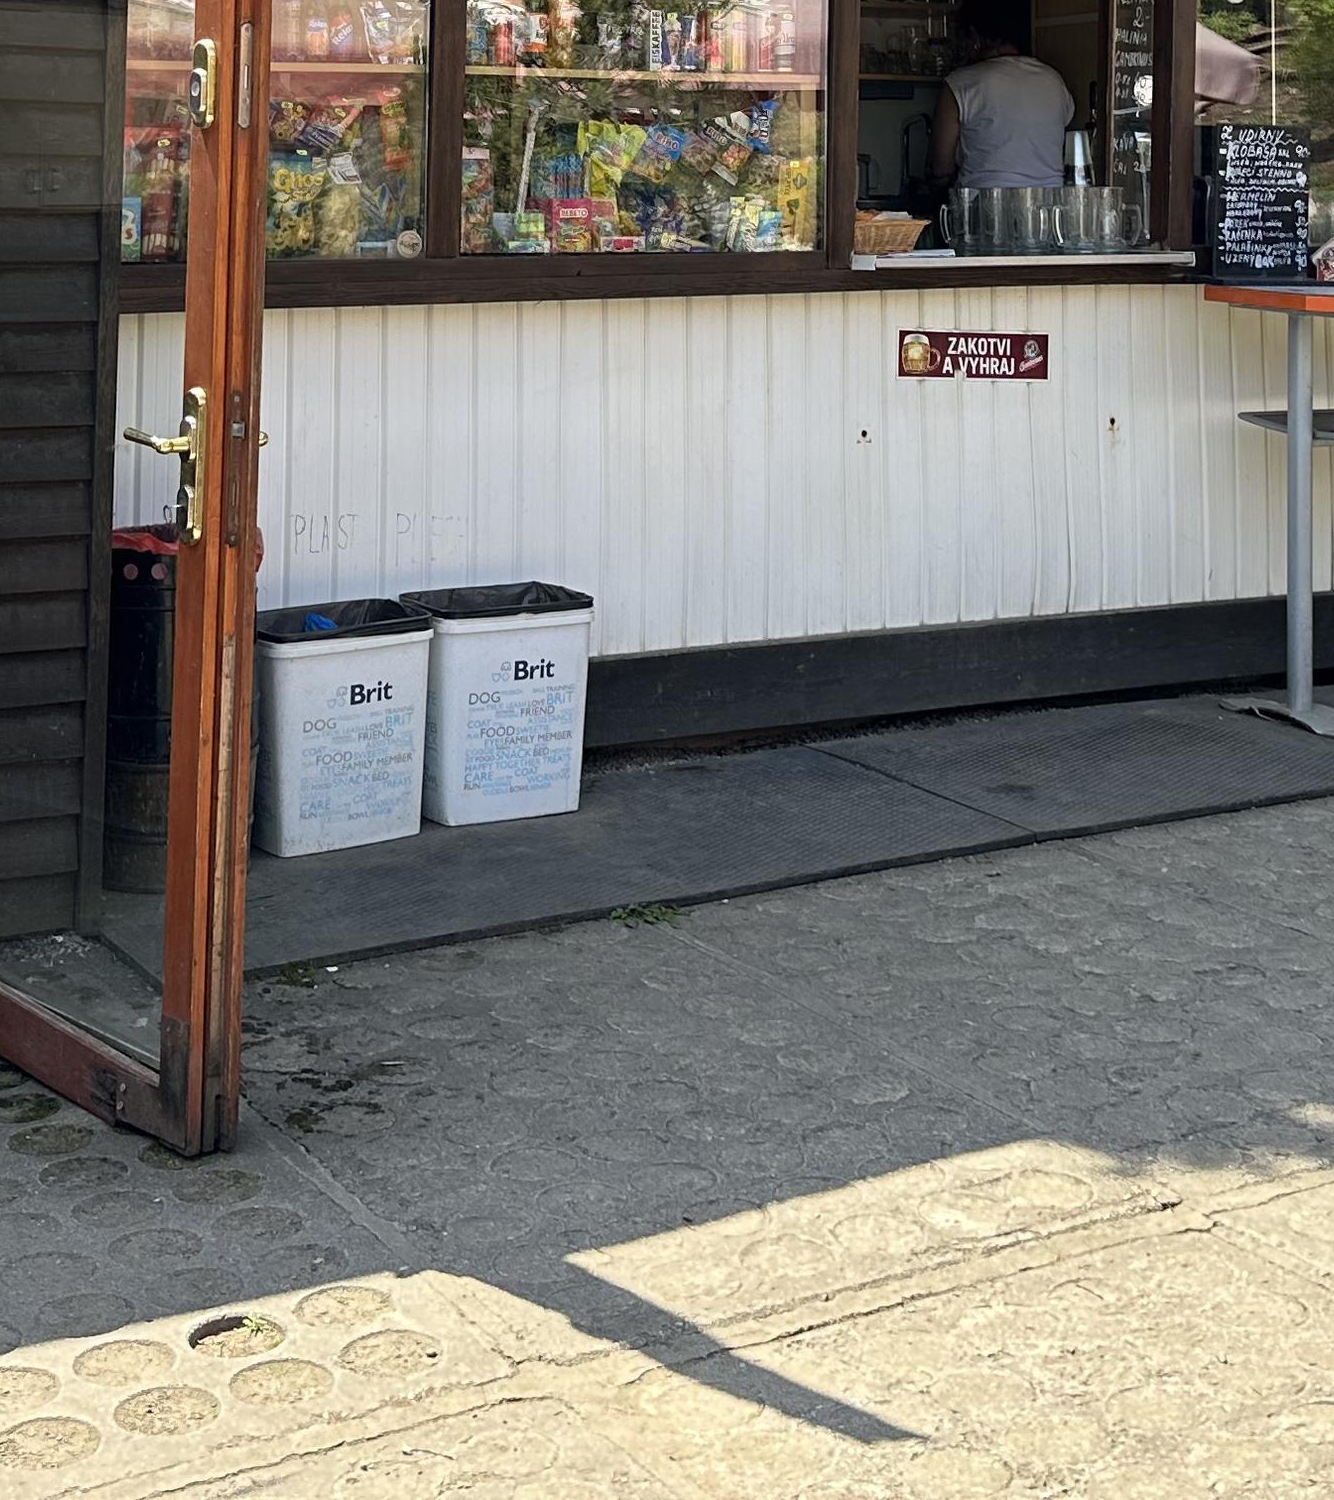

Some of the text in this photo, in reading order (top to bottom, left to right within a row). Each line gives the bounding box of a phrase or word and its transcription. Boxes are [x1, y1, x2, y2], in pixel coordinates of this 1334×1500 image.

[948, 337, 1011, 356] ZAKOTVI
[942, 357, 953, 374] A
[959, 357, 1015, 376] VYHRAJ
[514, 658, 555, 681] Brit
[350, 681, 393, 706] Brit
[468, 691, 501, 706] DOG
[546, 691, 573, 706] BRIT
[520, 705, 555, 718] FRIEND
[303, 718, 337, 733] DOG
[480, 725, 515, 739] FOOD
[357, 728, 394, 742] FRIEND
[504, 735, 535, 746] FAMILY
[537, 730, 572, 742] MEMBER
[316, 751, 353, 766] FOOD
[342, 759, 374, 771] FAMILY
[376, 752, 413, 766] MEMBER
[464, 772, 493, 784] CARE
